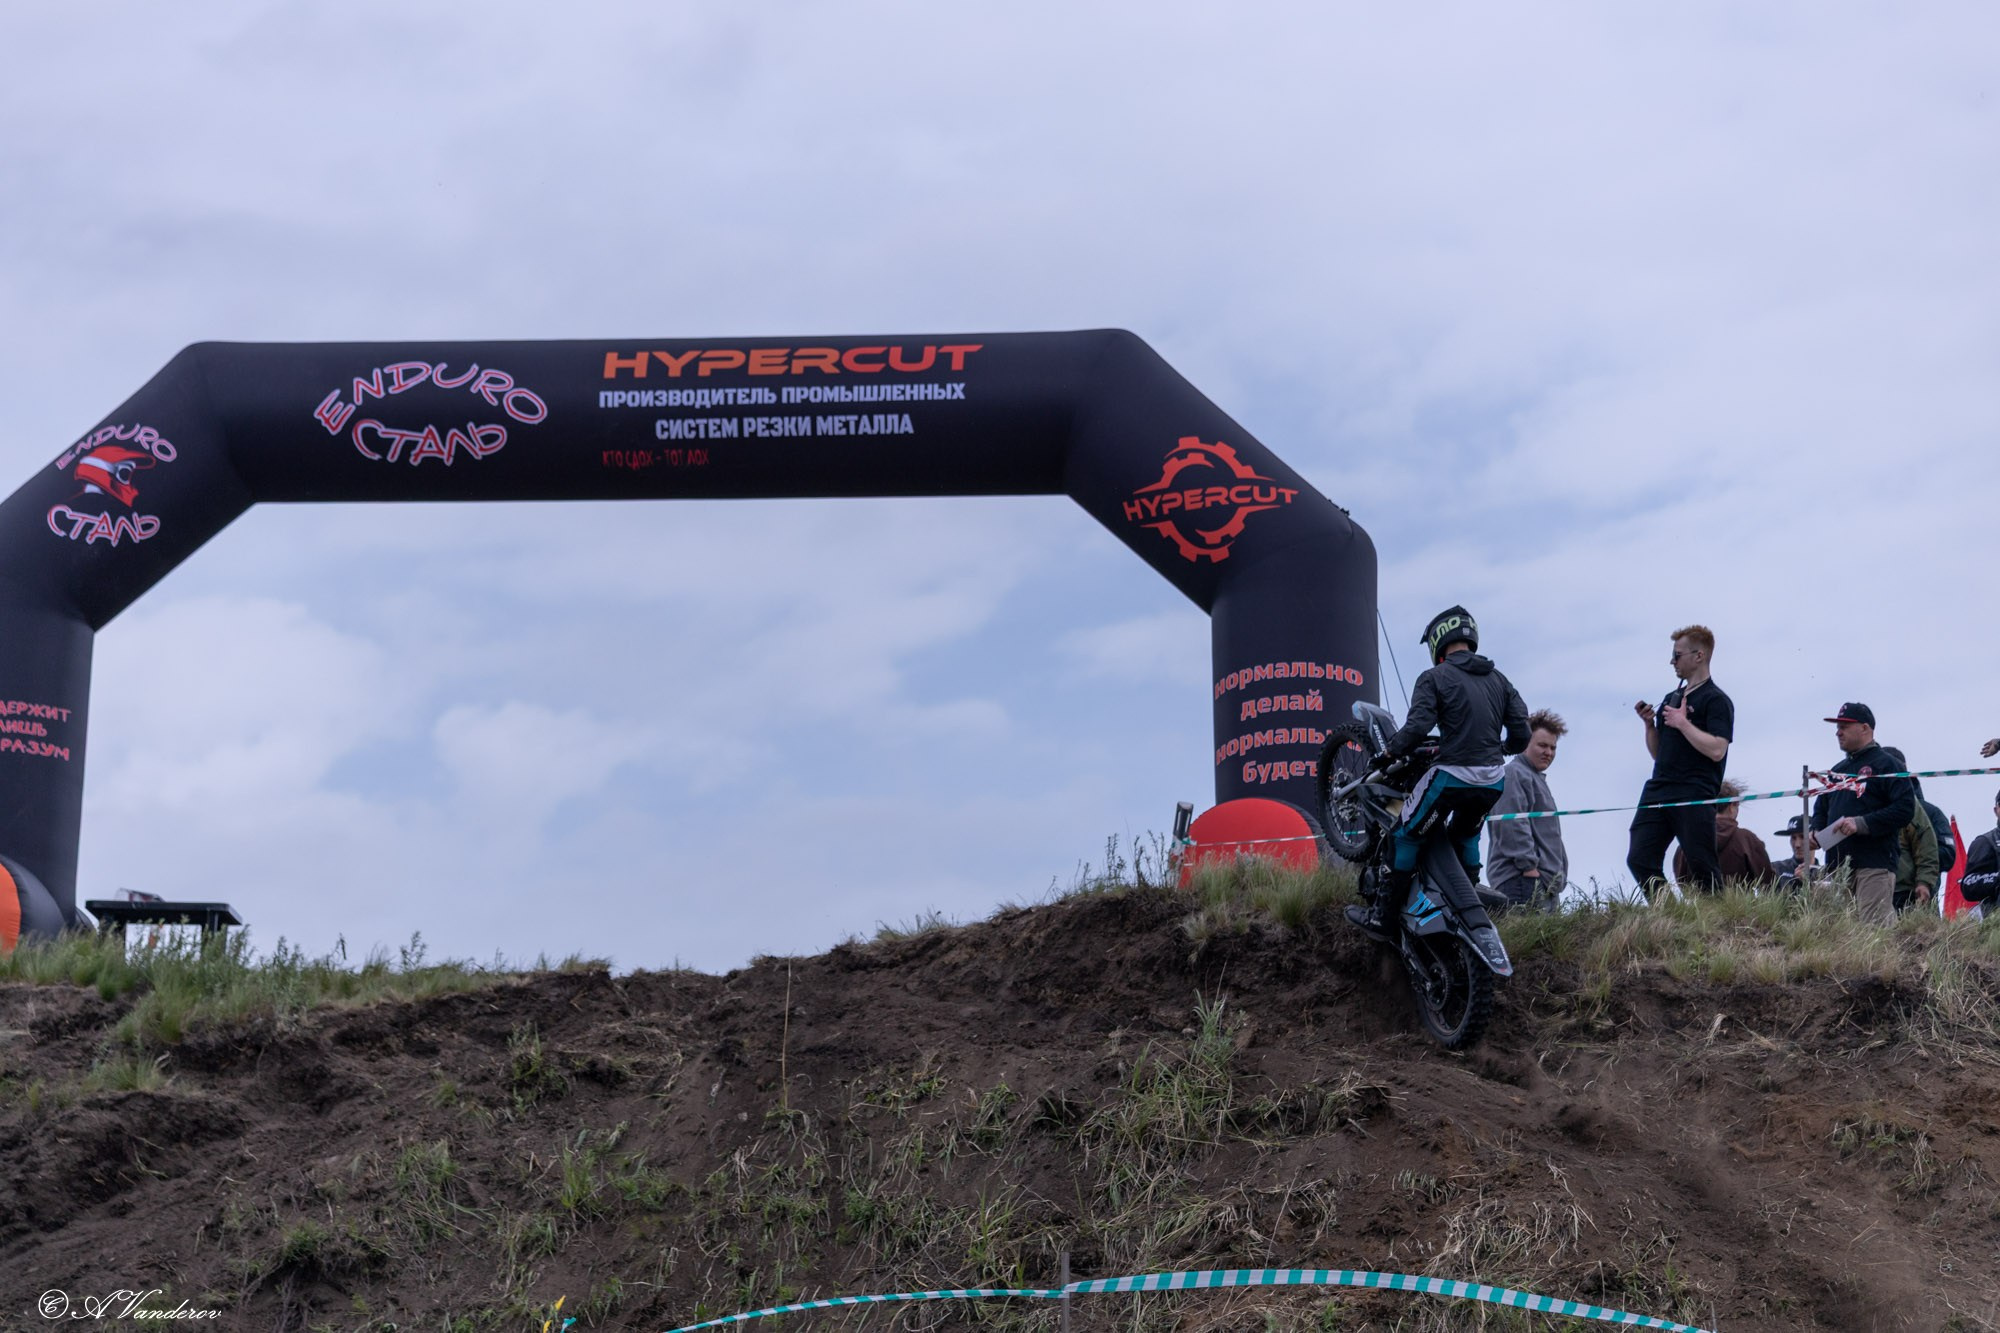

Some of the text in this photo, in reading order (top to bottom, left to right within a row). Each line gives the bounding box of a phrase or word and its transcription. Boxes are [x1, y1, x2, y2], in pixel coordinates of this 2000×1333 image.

[603, 345, 983, 379] HYPERCUT
[314, 361, 548, 436] ENDURO
[599, 383, 966, 409] ПРОИЗВОДИТЕЛЬ ПРОМЫШЛЕННЫХ
[655, 413, 914, 440] СИСТЕМ РЕЗКИ МЕТАЛЛА
[55, 423, 177, 470] ENDURO
[602, 450, 623, 467] КТО
[663, 448, 683, 467] ТОТ
[687, 448, 710, 466] ЛОХ
[1122, 485, 1299, 522] HYPERCUT
[1214, 661, 1364, 700] нормально
[1240, 688, 1324, 721] делай
[0, 738, 70, 761] РАЗУМ
[1216, 727, 1362, 766] нормаль
[1242, 760, 1318, 785] будет
